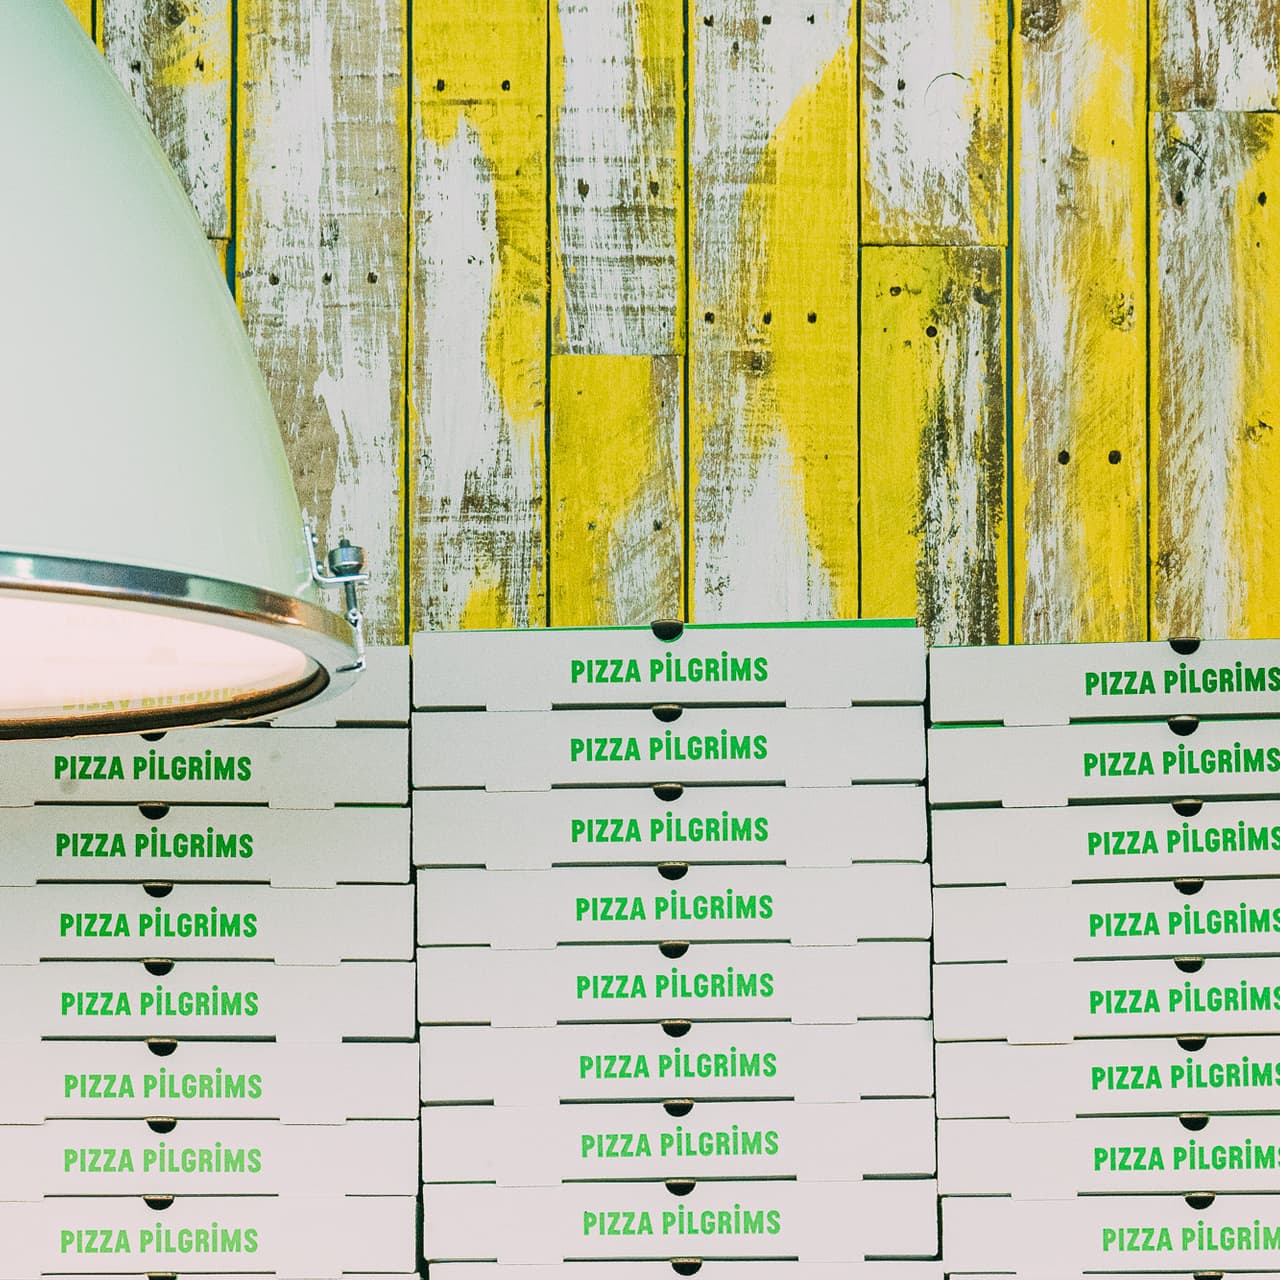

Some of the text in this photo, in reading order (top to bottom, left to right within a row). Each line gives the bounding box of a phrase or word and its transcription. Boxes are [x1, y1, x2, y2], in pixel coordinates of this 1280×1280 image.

[571, 658, 641, 684] PIZZA
[1085, 671, 1156, 697] PIZZA
[570, 737, 641, 763] PIZZA
[54, 755, 124, 780] PIZZA
[1083, 752, 1155, 777] PIZZA
[571, 818, 642, 843] PIZZA
[1088, 830, 1159, 856] PIZZA
[56, 832, 126, 858] PIZZA
[60, 913, 130, 938] PIZZA
[1089, 912, 1160, 938] PIZZA
[576, 975, 647, 999] PIZZA
[61, 992, 131, 1017] PIZZA
[579, 1055, 650, 1079] PIZZA
[1091, 1065, 1162, 1091] PIZZA
[581, 1133, 652, 1158] PIZZA
[64, 1148, 134, 1172] PIZZA
[1094, 1146, 1165, 1171] PIZZA
[61, 1230, 130, 1253] PIZZA
[1103, 1227, 1173, 1252] PIZZA
